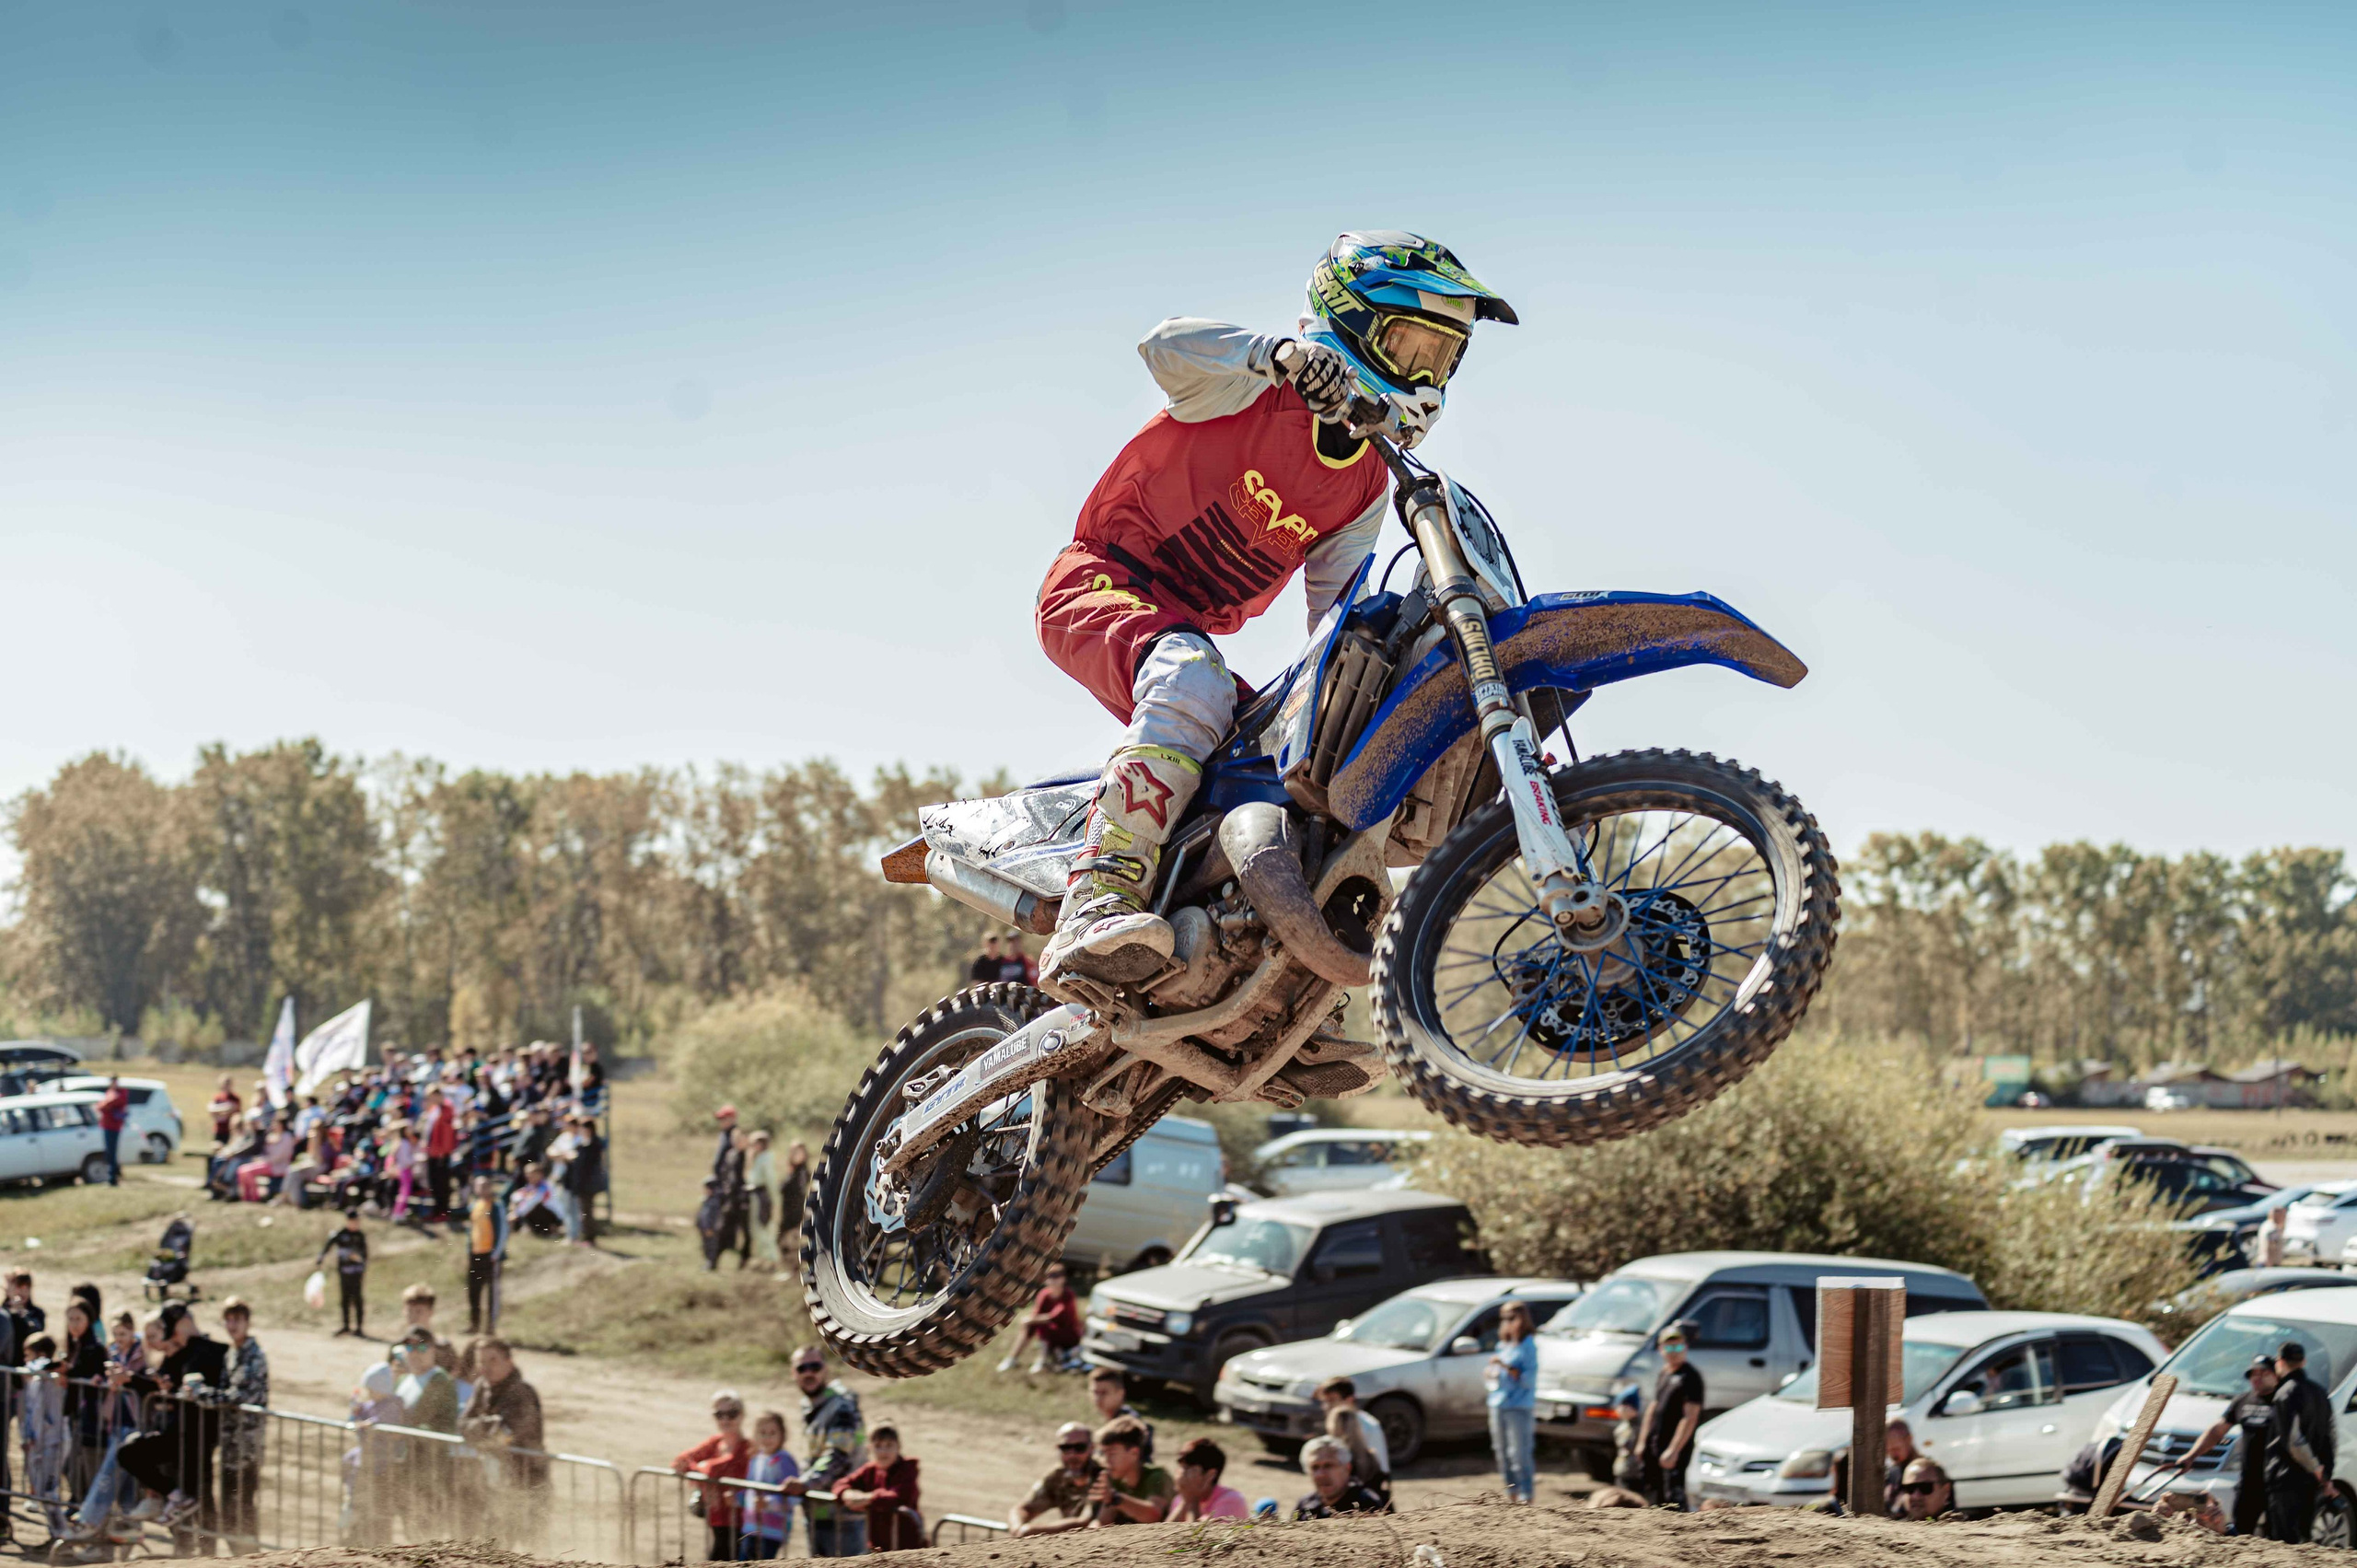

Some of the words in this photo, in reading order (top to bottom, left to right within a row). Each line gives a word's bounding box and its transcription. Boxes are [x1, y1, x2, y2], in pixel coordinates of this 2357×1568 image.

[1314, 258, 1365, 315] LEATT
[1365, 315, 1379, 342] LEATT
[1529, 781, 1552, 826] BRAKING
[983, 1036, 1028, 1072] YAMALUBE
